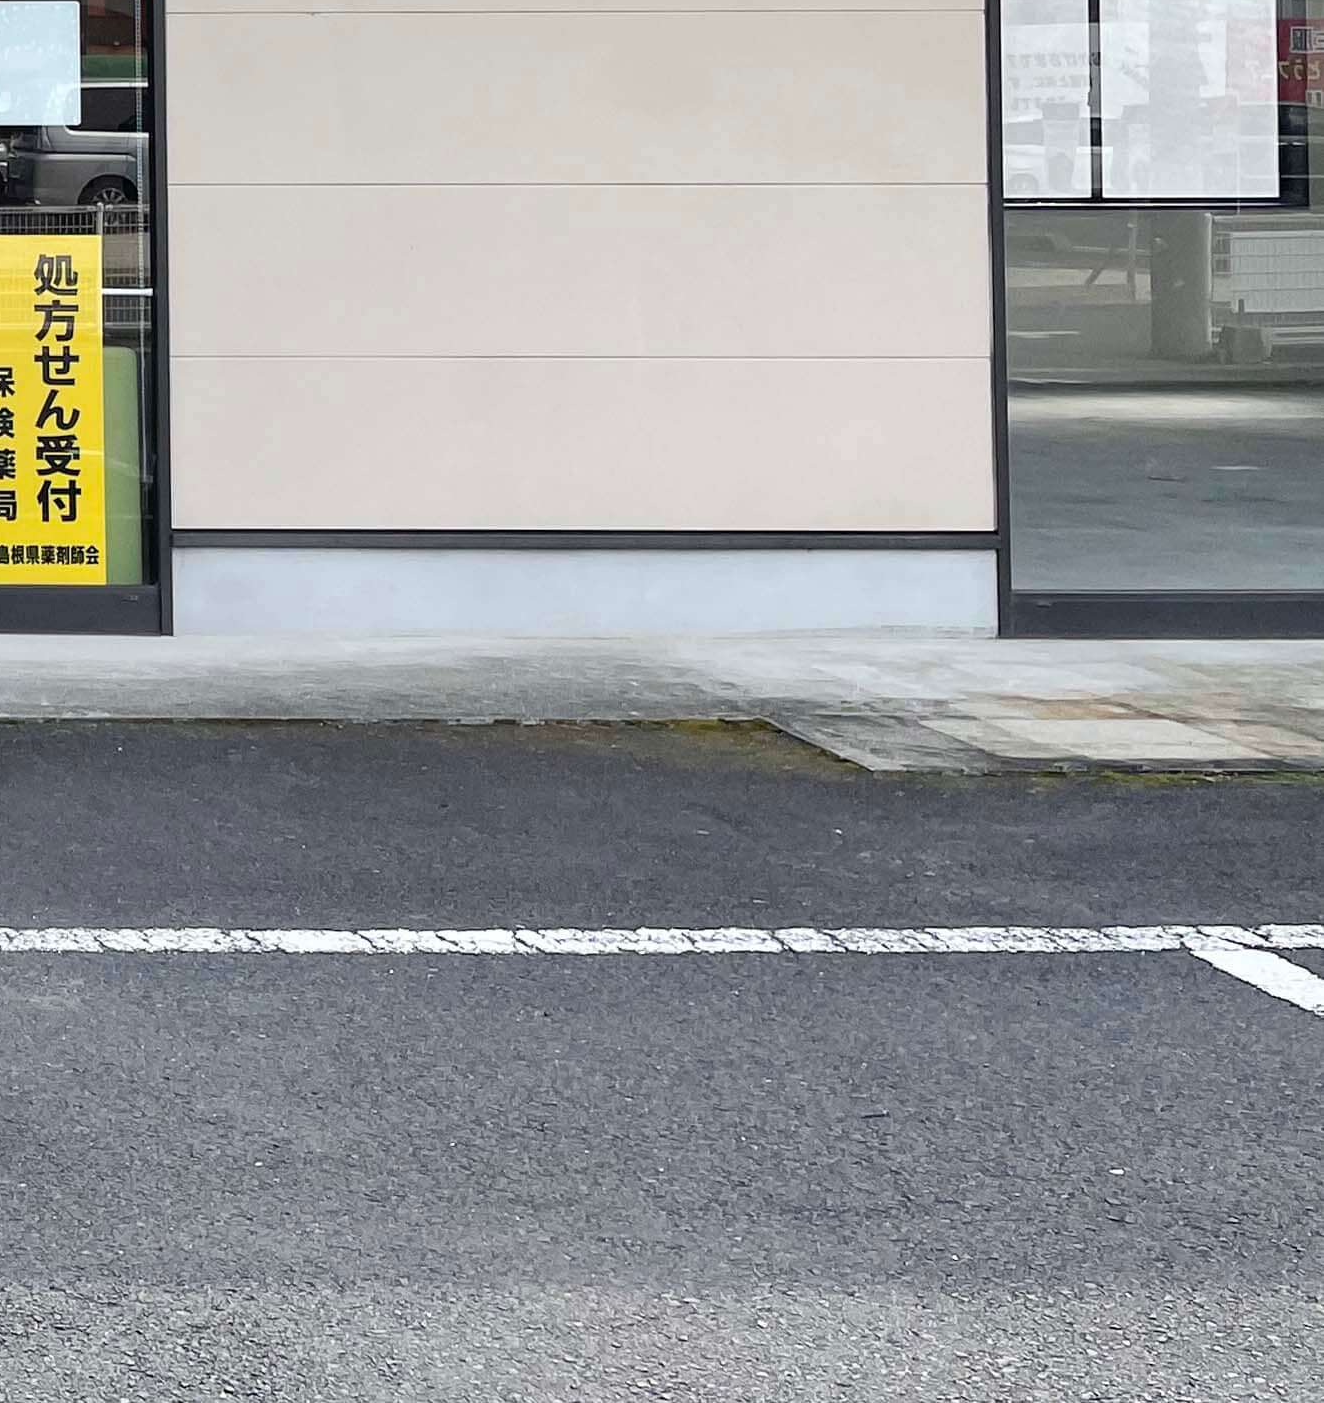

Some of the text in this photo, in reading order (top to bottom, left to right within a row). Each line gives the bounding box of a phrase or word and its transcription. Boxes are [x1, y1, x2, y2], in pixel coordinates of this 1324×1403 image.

[34, 253, 82, 524] 処方せん受付
